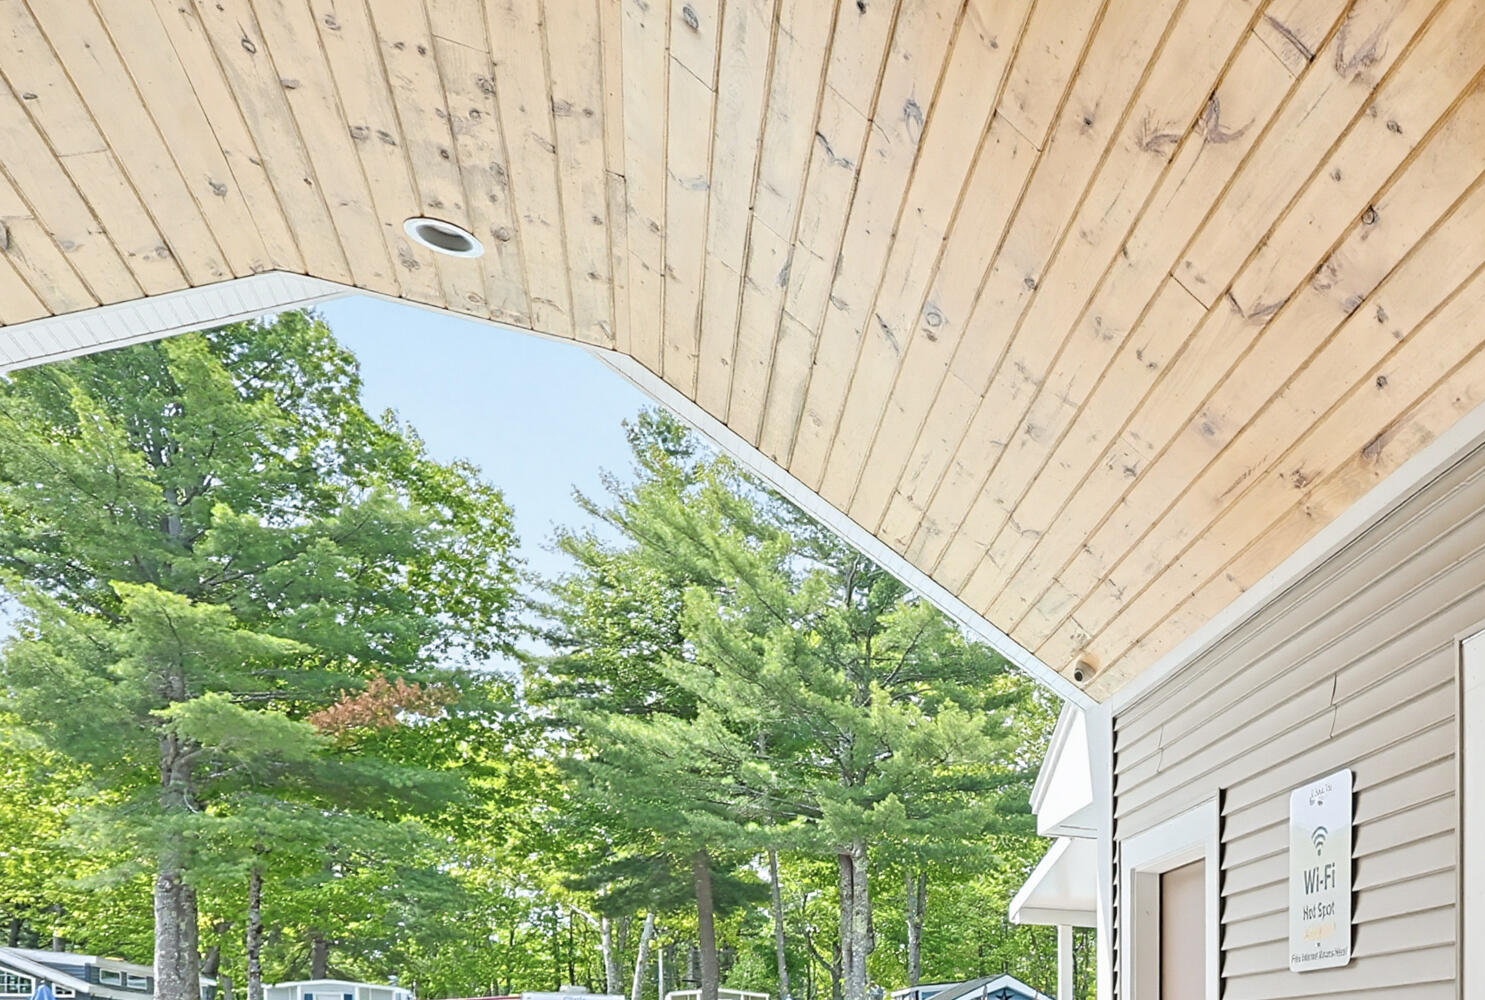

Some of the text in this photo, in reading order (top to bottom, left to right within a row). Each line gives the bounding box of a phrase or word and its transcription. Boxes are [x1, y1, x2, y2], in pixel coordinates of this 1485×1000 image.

[1304, 862, 1335, 895] Wi-Fi
[1303, 902, 1335, 920] Hot Spot
